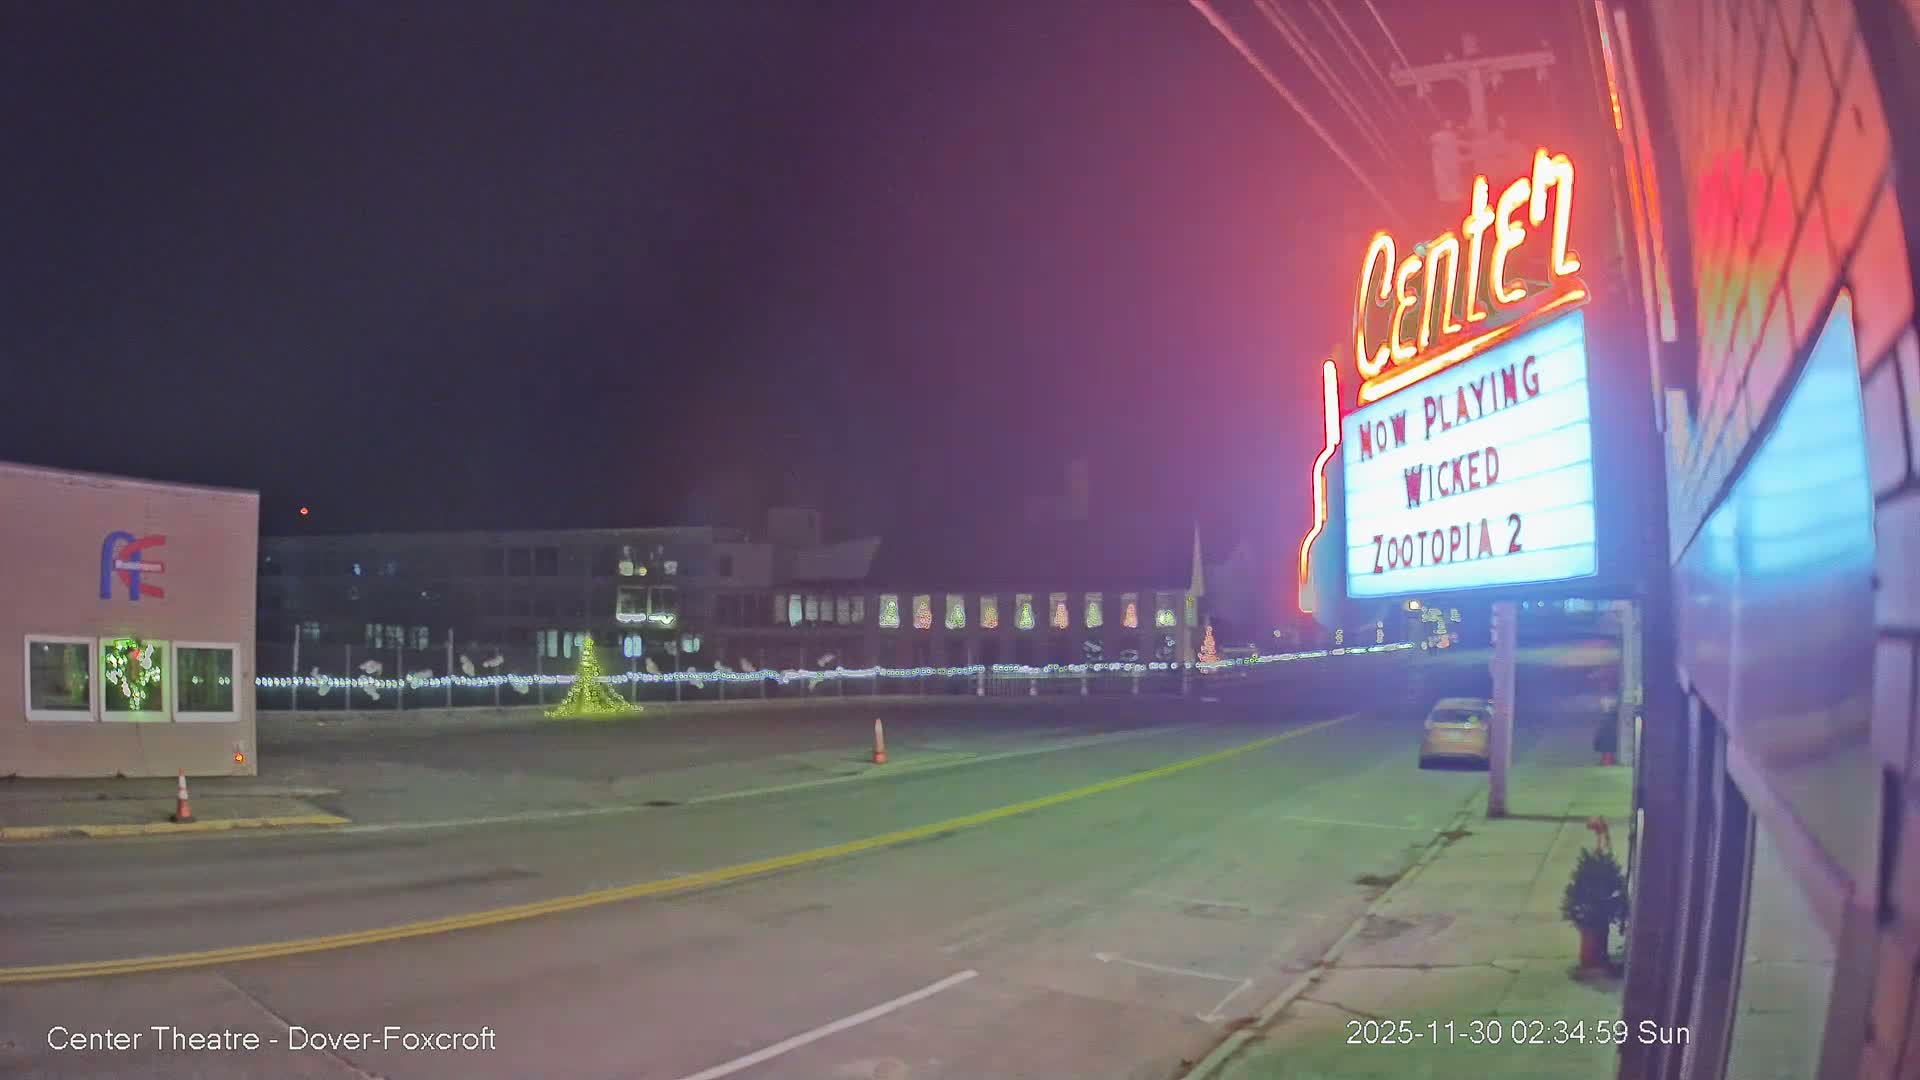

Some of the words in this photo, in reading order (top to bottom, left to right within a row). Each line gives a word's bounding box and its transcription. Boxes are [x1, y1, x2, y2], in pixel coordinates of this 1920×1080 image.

[1359, 410, 1406, 462] NOW
[1424, 355, 1540, 440] PLAYING
[1404, 447, 1499, 509] WICKED
[1373, 518, 1493, 574] ZOOTOPIA
[1508, 513, 1522, 553] 2
